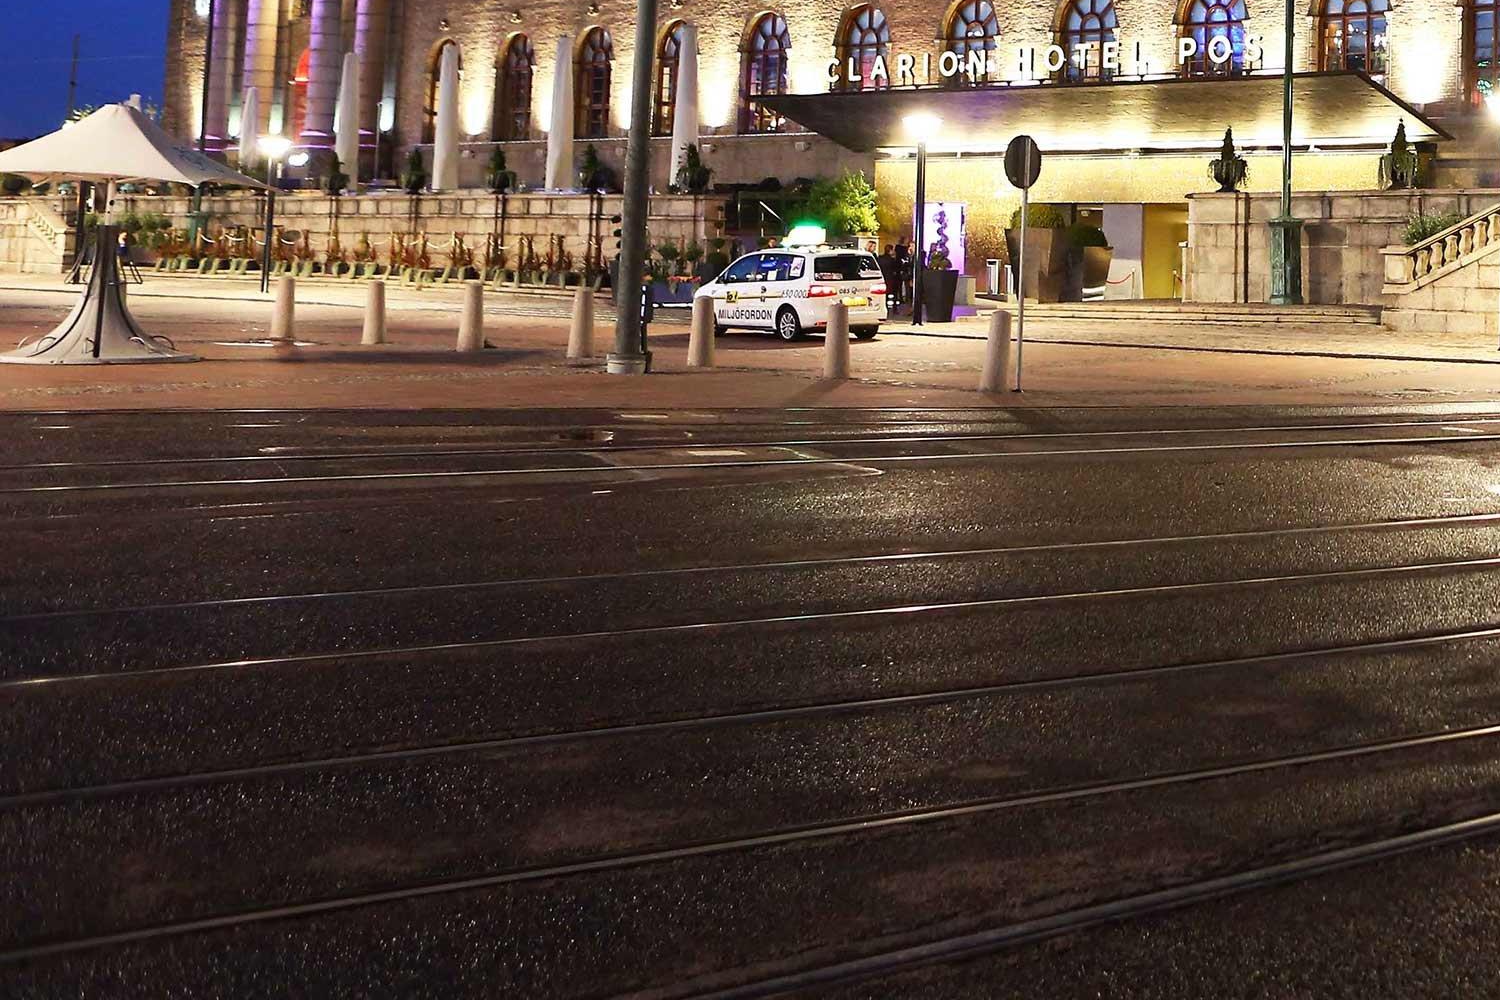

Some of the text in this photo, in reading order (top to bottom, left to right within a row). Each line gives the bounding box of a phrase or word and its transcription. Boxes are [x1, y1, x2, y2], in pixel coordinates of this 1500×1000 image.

[825, 35, 1265, 83] CLARION HOTEL POS
[718, 307, 773, 320] MILJÖFORDON
